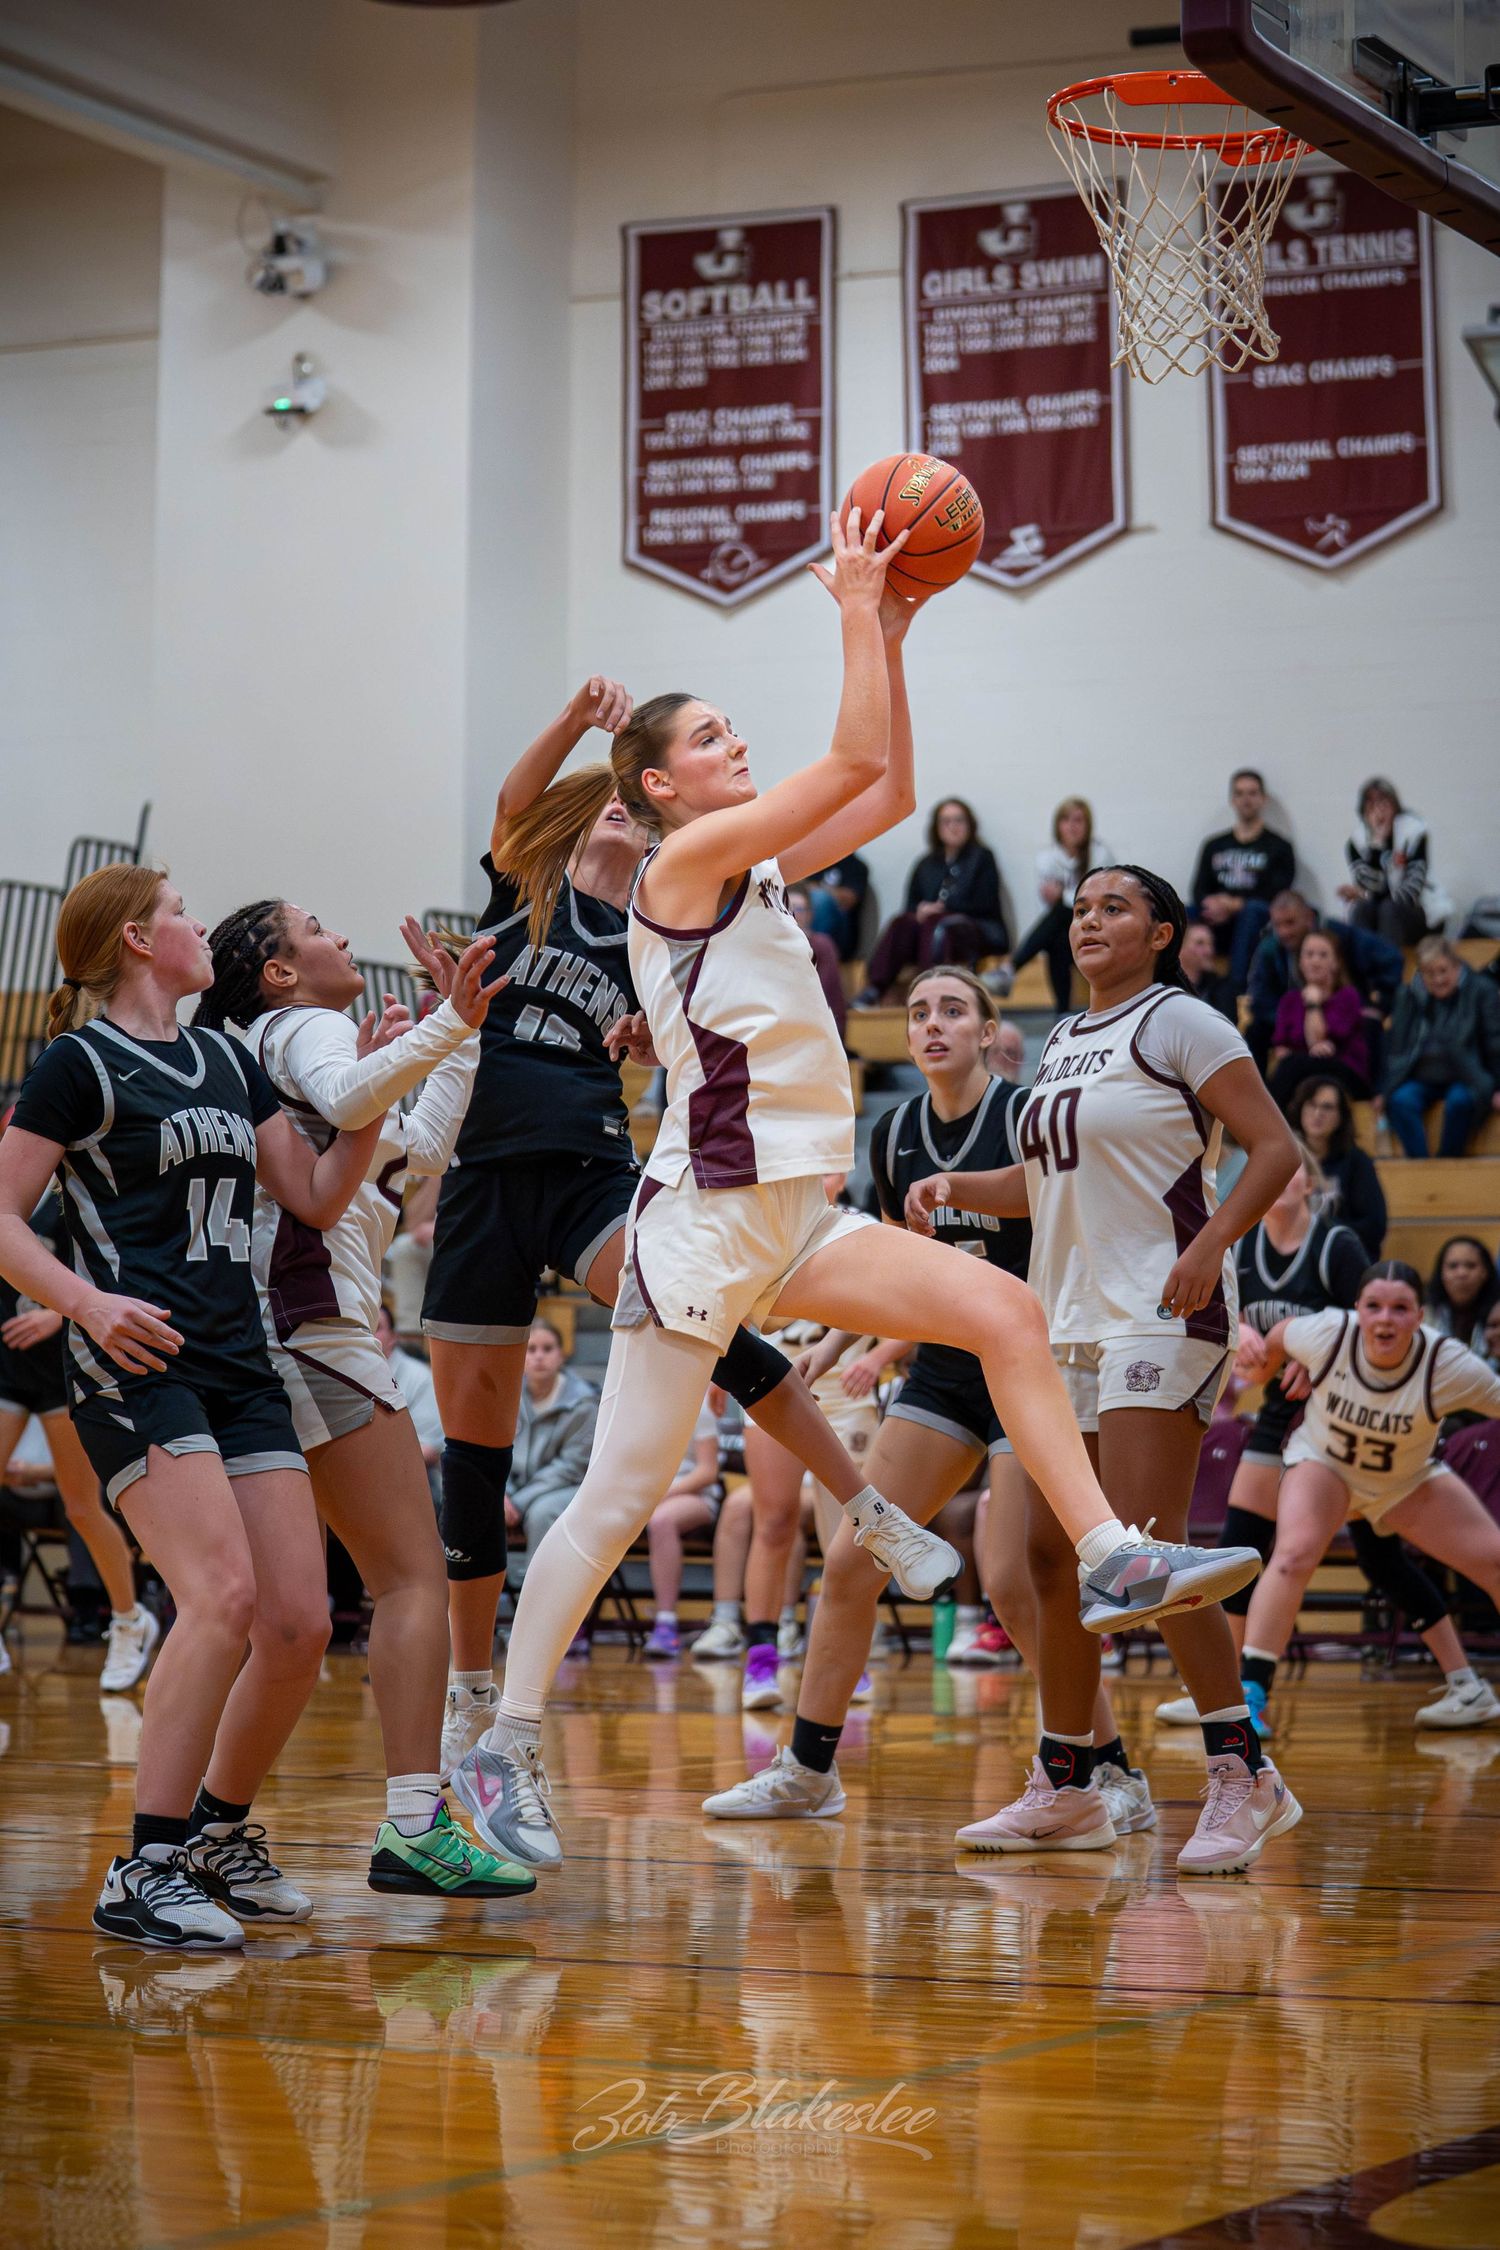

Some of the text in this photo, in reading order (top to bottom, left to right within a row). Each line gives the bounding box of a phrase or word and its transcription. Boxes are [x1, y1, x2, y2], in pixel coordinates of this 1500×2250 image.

[1313, 228, 1417, 267] TENNIS
[922, 253, 1105, 299] GIRLS SWIM
[1322, 267, 1407, 290] CHAMPS
[641, 277, 816, 323] SOFTBALL
[1252, 354, 1398, 389] STAC CHAMPS
[664, 402, 795, 433] STAC CHAMPS
[928, 388, 1101, 424] SECTIONAL CHAMPS
[646, 450, 814, 480] SECTIONAL CHAMPS
[1236, 430, 1416, 467] SECTIONAL CHAMPS
[734, 499, 808, 523] CHAMPS
[505, 944, 629, 1041] ATHENS
[1033, 1048, 1114, 1088] WILDCATS
[158, 1106, 258, 1177] ATHENS
[1020, 1086, 1083, 1178] 40
[185, 1177, 251, 1263] 14
[1325, 1391, 1415, 1435] WILDCATS
[1324, 1424, 1397, 1473] 33
